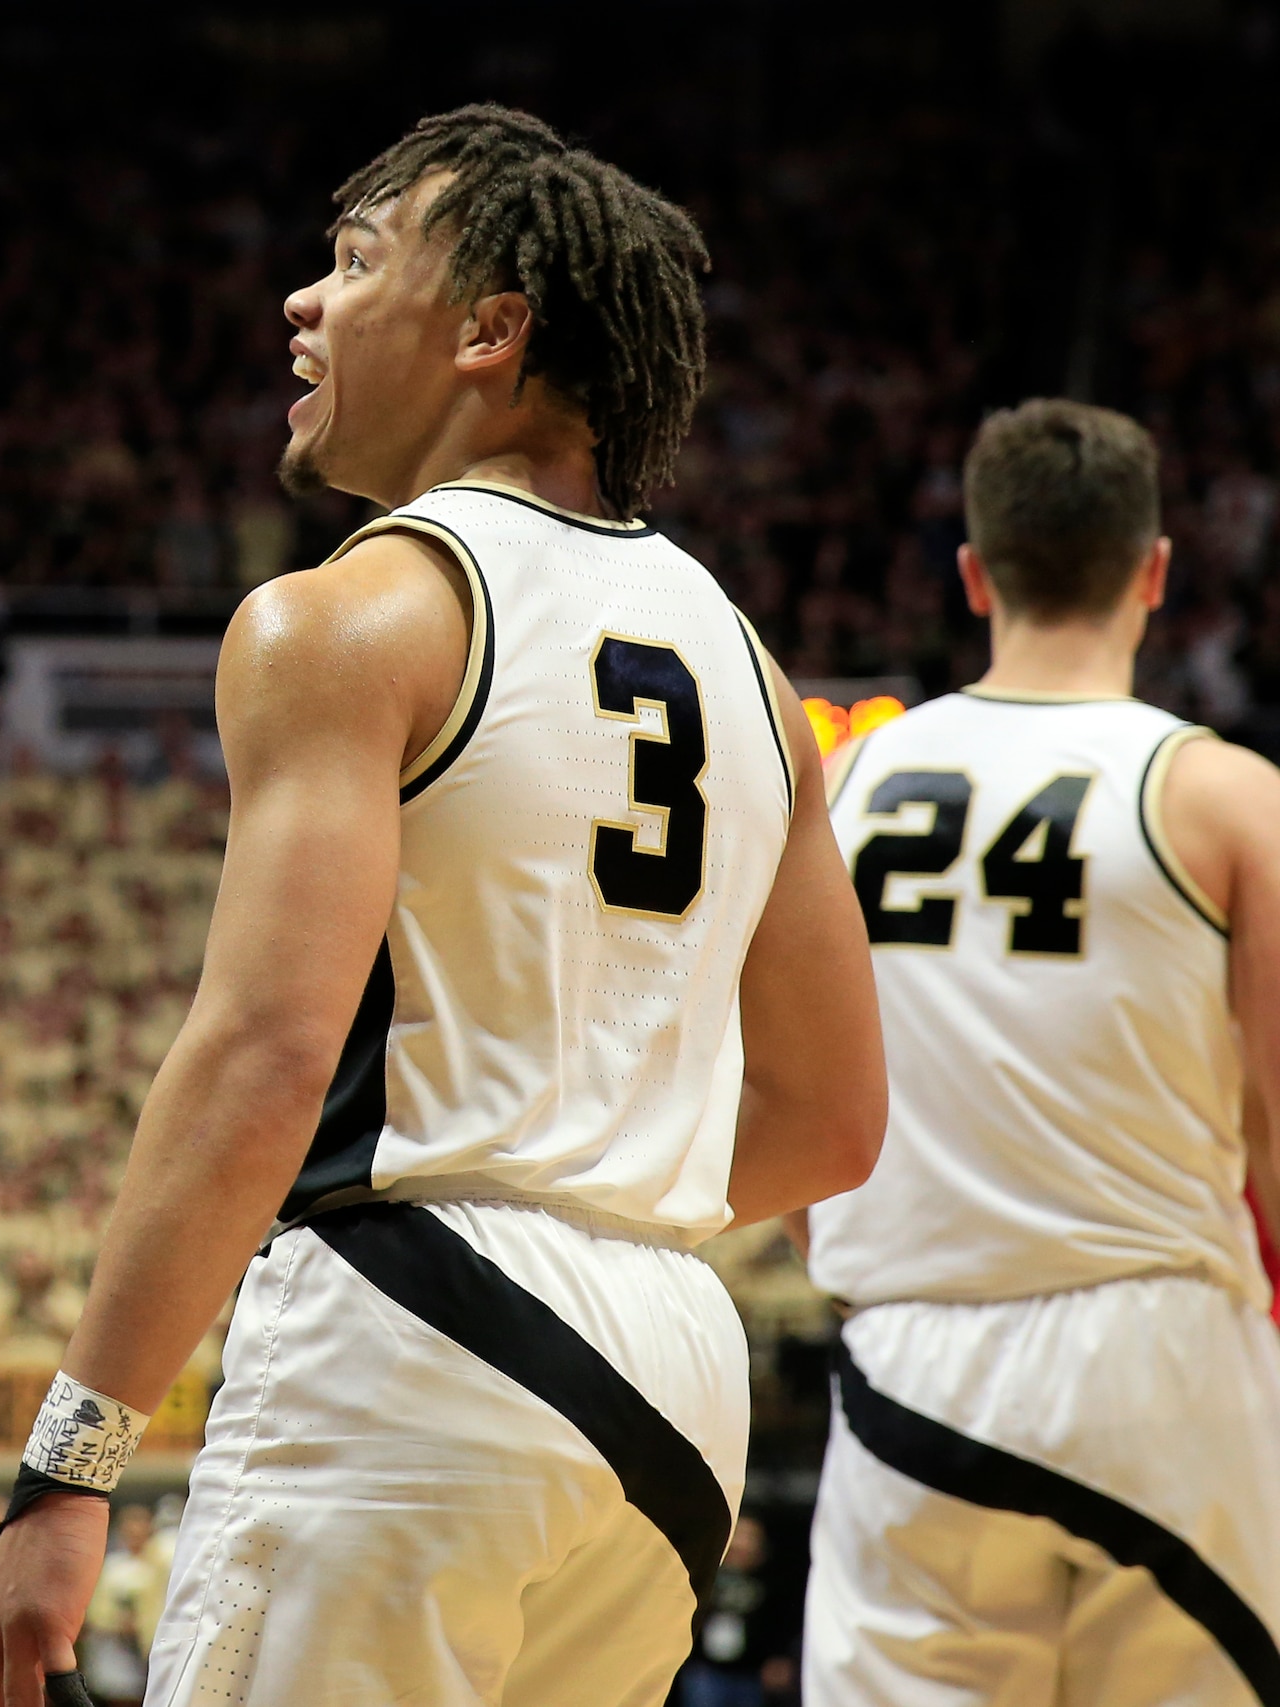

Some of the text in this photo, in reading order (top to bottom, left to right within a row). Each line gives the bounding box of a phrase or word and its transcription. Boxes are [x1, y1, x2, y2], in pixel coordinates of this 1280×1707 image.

[588, 629, 710, 924] 3
[852, 765, 1101, 961] 24
[69, 1442, 97, 1482] FUN
